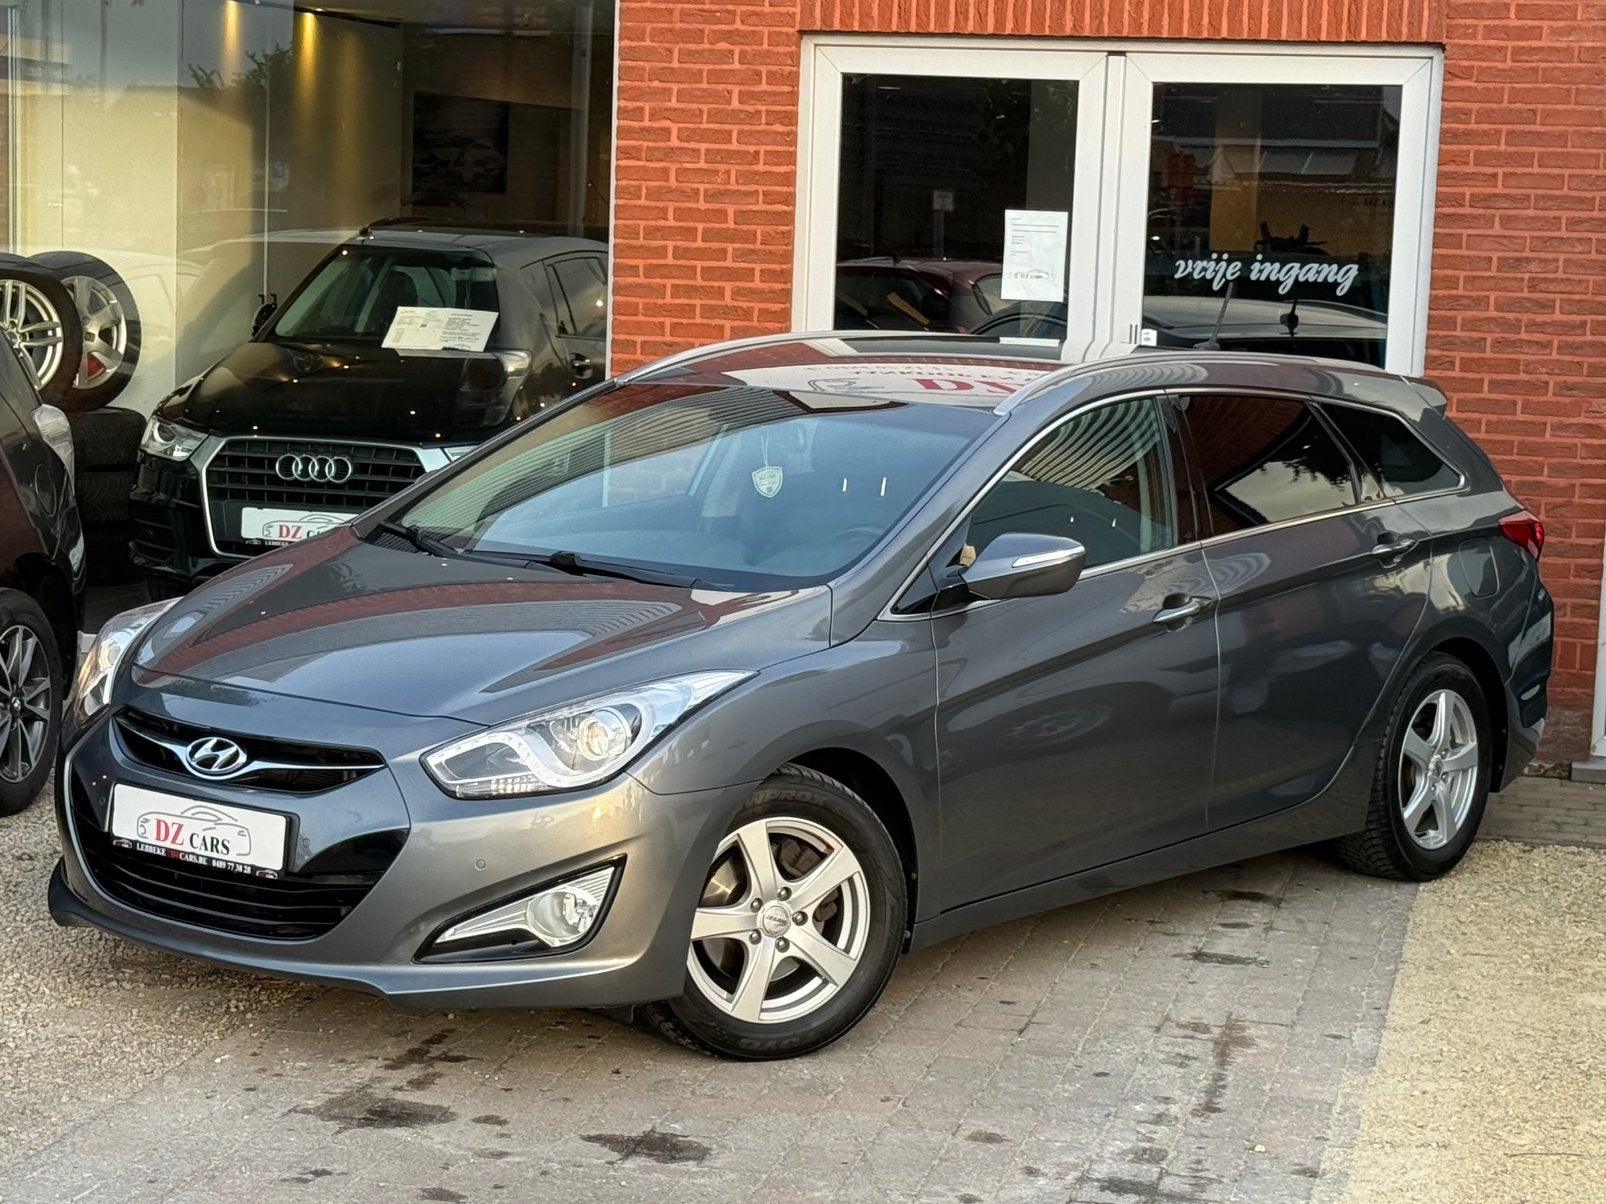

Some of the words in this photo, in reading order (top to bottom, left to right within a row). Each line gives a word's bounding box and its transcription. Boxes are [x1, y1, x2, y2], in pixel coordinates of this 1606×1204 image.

[1173, 252, 1242, 291] vrije
[1249, 252, 1360, 296] ingang
[278, 524, 303, 539] DZ
[154, 818, 184, 846] DZ
[189, 832, 231, 856] CARS
